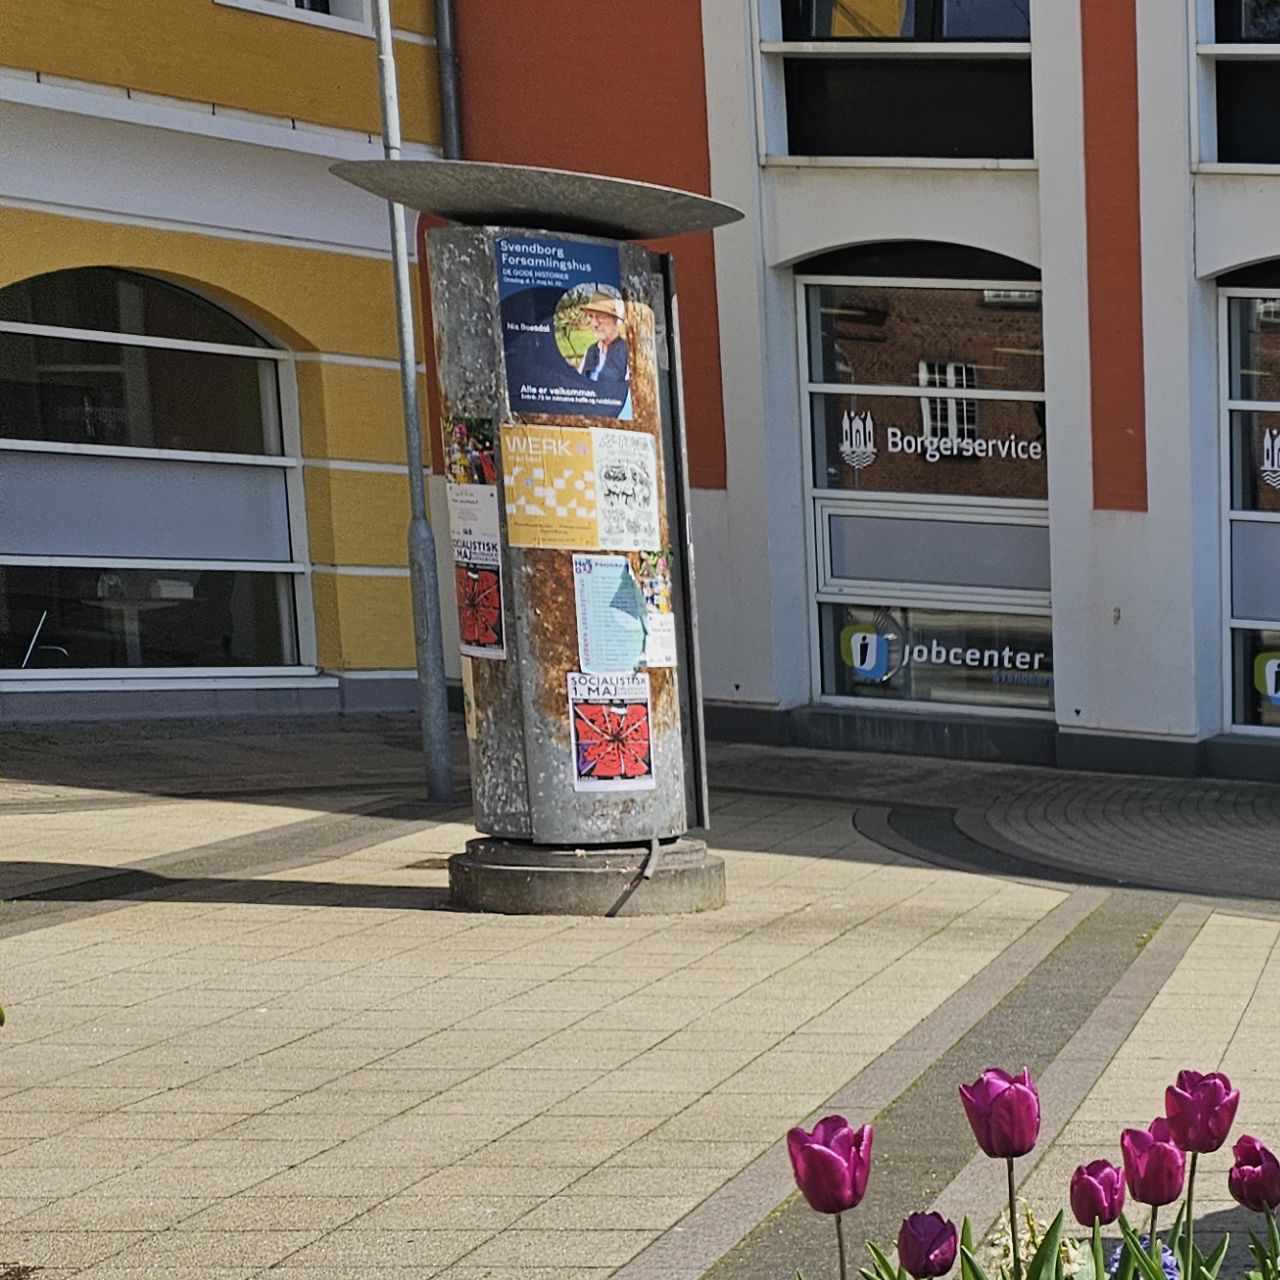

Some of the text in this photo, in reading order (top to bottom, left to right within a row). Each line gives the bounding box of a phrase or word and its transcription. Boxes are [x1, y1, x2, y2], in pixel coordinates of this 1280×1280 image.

[500, 240, 565, 259] Svendborg
[502, 253, 592, 273] Forsamlingshus
[520, 384, 537, 394] Alle
[505, 435, 573, 457] WERK
[887, 427, 1043, 463] Borgerservice
[901, 639, 1045, 670] jobcenter
[587, 687, 618, 697] MAJ
